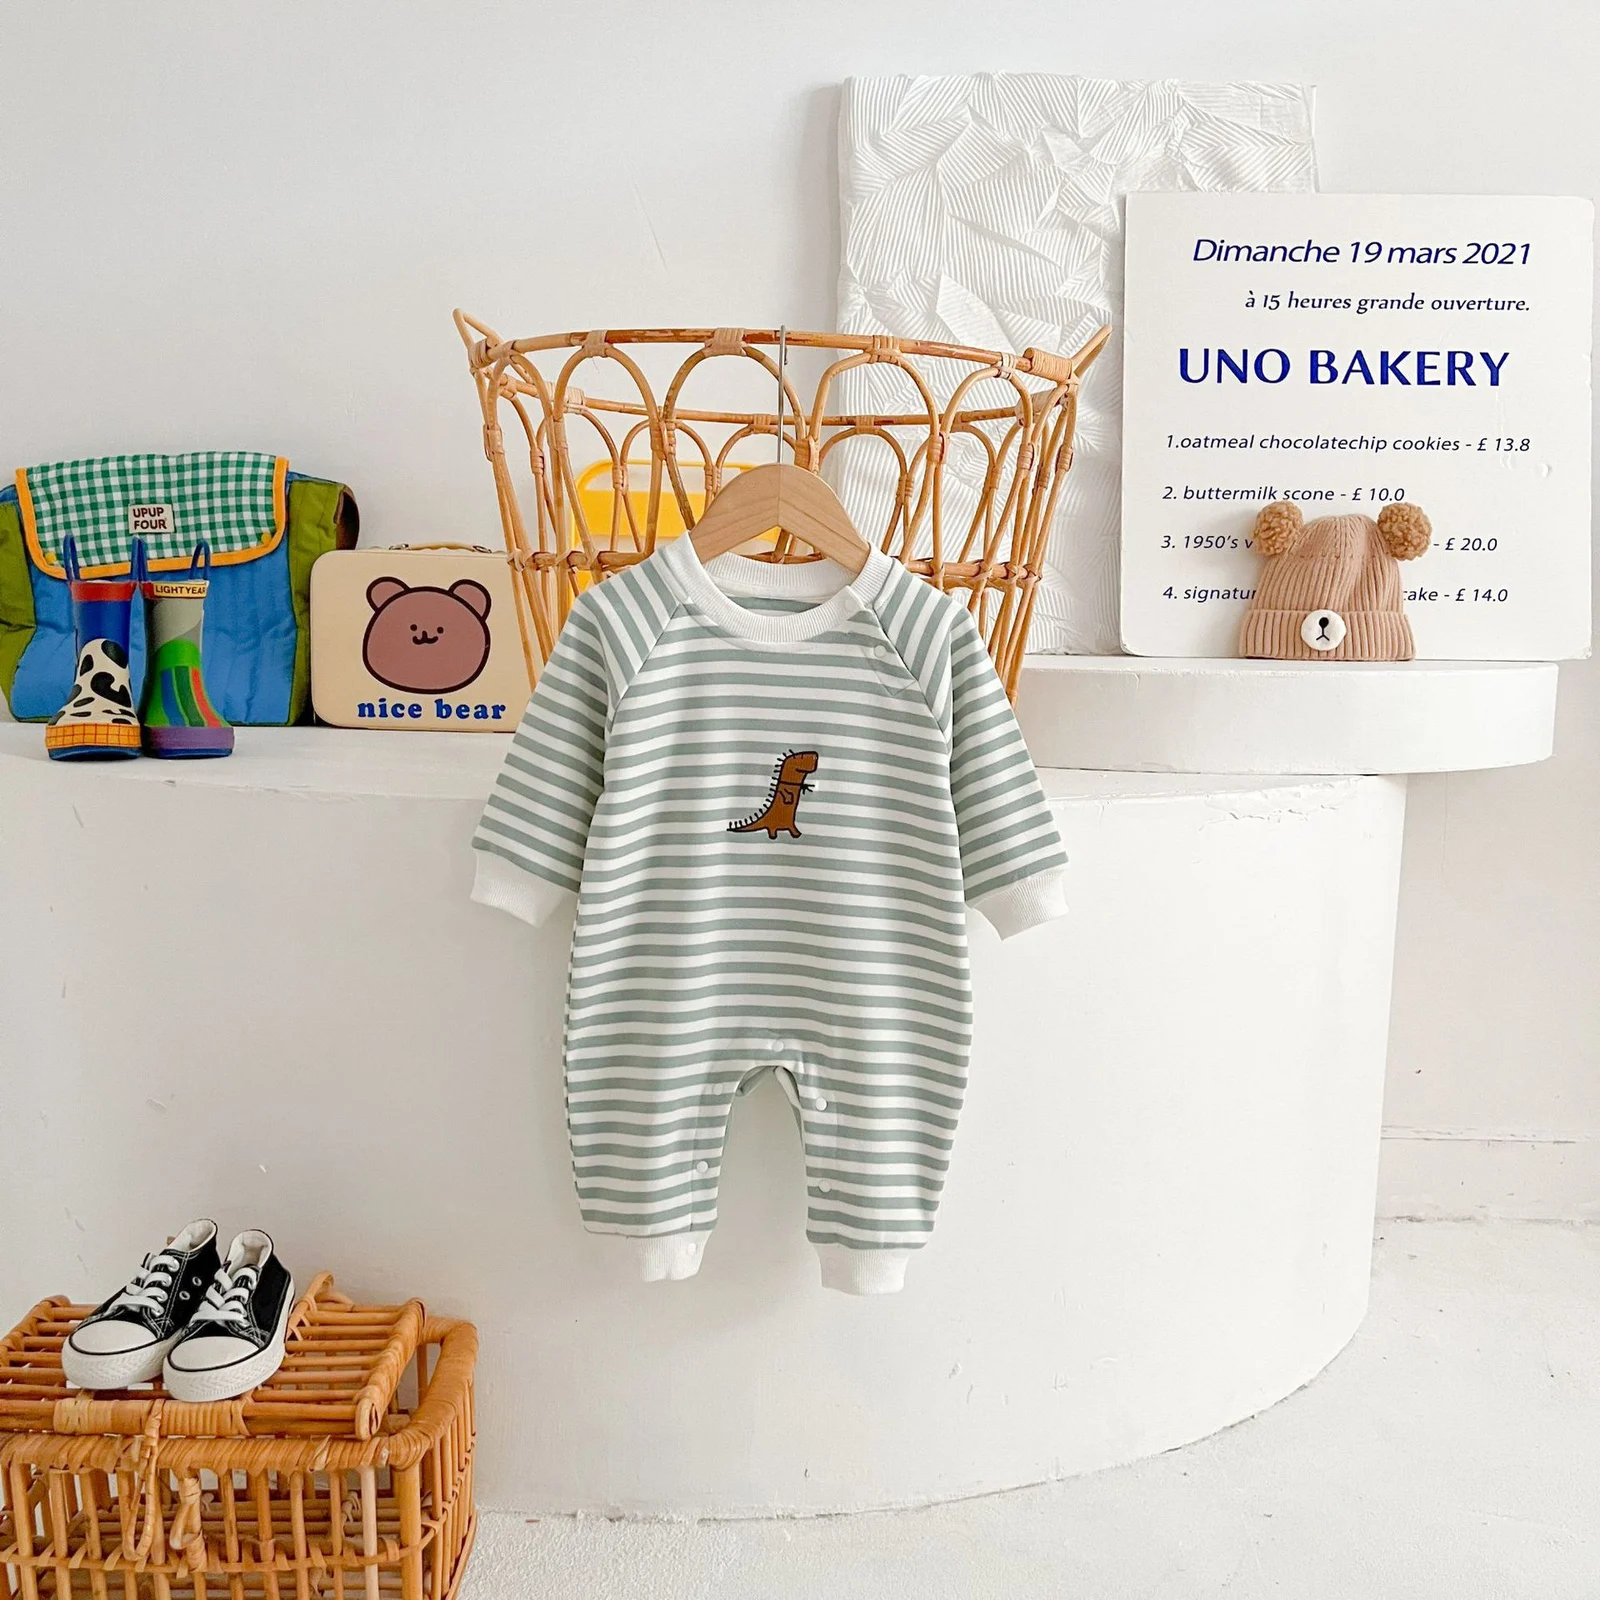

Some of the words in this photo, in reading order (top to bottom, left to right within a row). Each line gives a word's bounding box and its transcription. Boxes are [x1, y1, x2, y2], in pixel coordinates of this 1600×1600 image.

[1192, 238, 1341, 264] Dimanche
[1349, 241, 1384, 264] 19
[1386, 246, 1458, 265] mars
[1461, 242, 1532, 266] 2021
[1245, 290, 1256, 309] à
[1262, 294, 1281, 311] 15
[1287, 290, 1352, 310] heures
[1355, 291, 1425, 315] grande
[1430, 297, 1531, 312] ouverture.
[1178, 347, 1291, 385] UNO
[1308, 349, 1511, 387] BAKERY
[1166, 434, 1255, 450] 1.oatmeal
[1259, 434, 1388, 454] chocolatechip
[1392, 436, 1460, 452] cookies
[1476, 437, 1488, 452] £
[1494, 437, 1531, 452] 13.8
[1162, 486, 1178, 500] 2.
[1183, 485, 1277, 501] buttermilk
[1281, 489, 1335, 501] scone
[1351, 487, 1363, 501] £
[1369, 487, 1405, 502] 10.0
[132, 506, 165, 518] UPUP
[133, 519, 167, 531] FOUR
[1160, 535, 1176, 549] 3.
[1444, 537, 1456, 551] £
[1460, 537, 1499, 552] 20.0
[1162, 586, 1178, 600] 4.
[1183, 585, 1257, 604] signatur
[1455, 588, 1466, 602] £
[1472, 588, 1509, 602] 14.0
[357, 697, 423, 719] nice
[434, 698, 506, 720] bear
